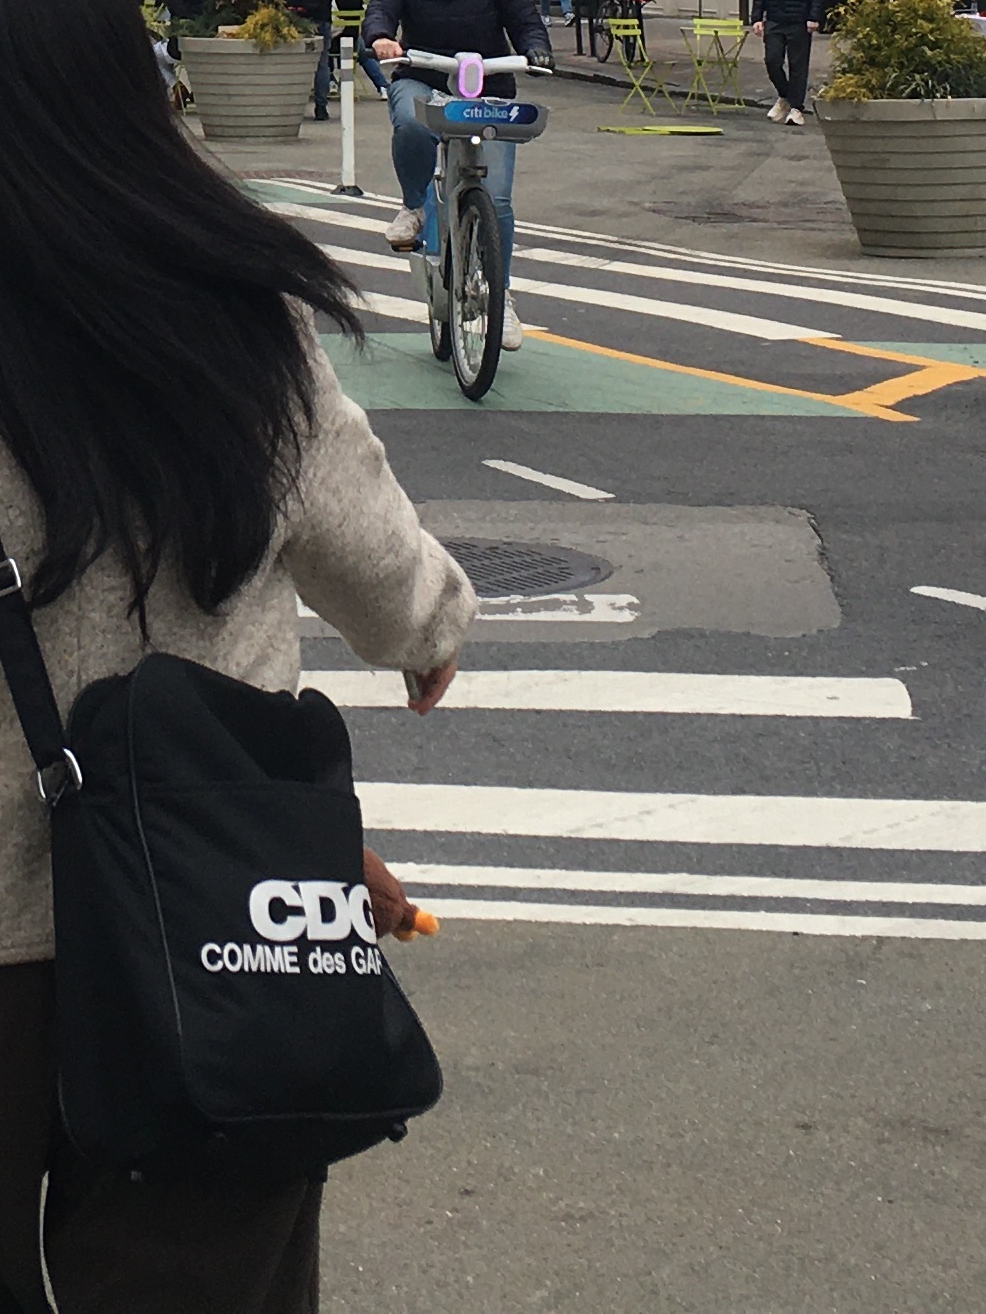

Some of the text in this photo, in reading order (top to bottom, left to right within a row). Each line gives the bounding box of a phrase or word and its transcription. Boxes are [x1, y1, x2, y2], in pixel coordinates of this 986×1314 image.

[463, 107, 508, 119] citi bike
[201, 942, 301, 974] COMME
[308, 946, 346, 974] des
